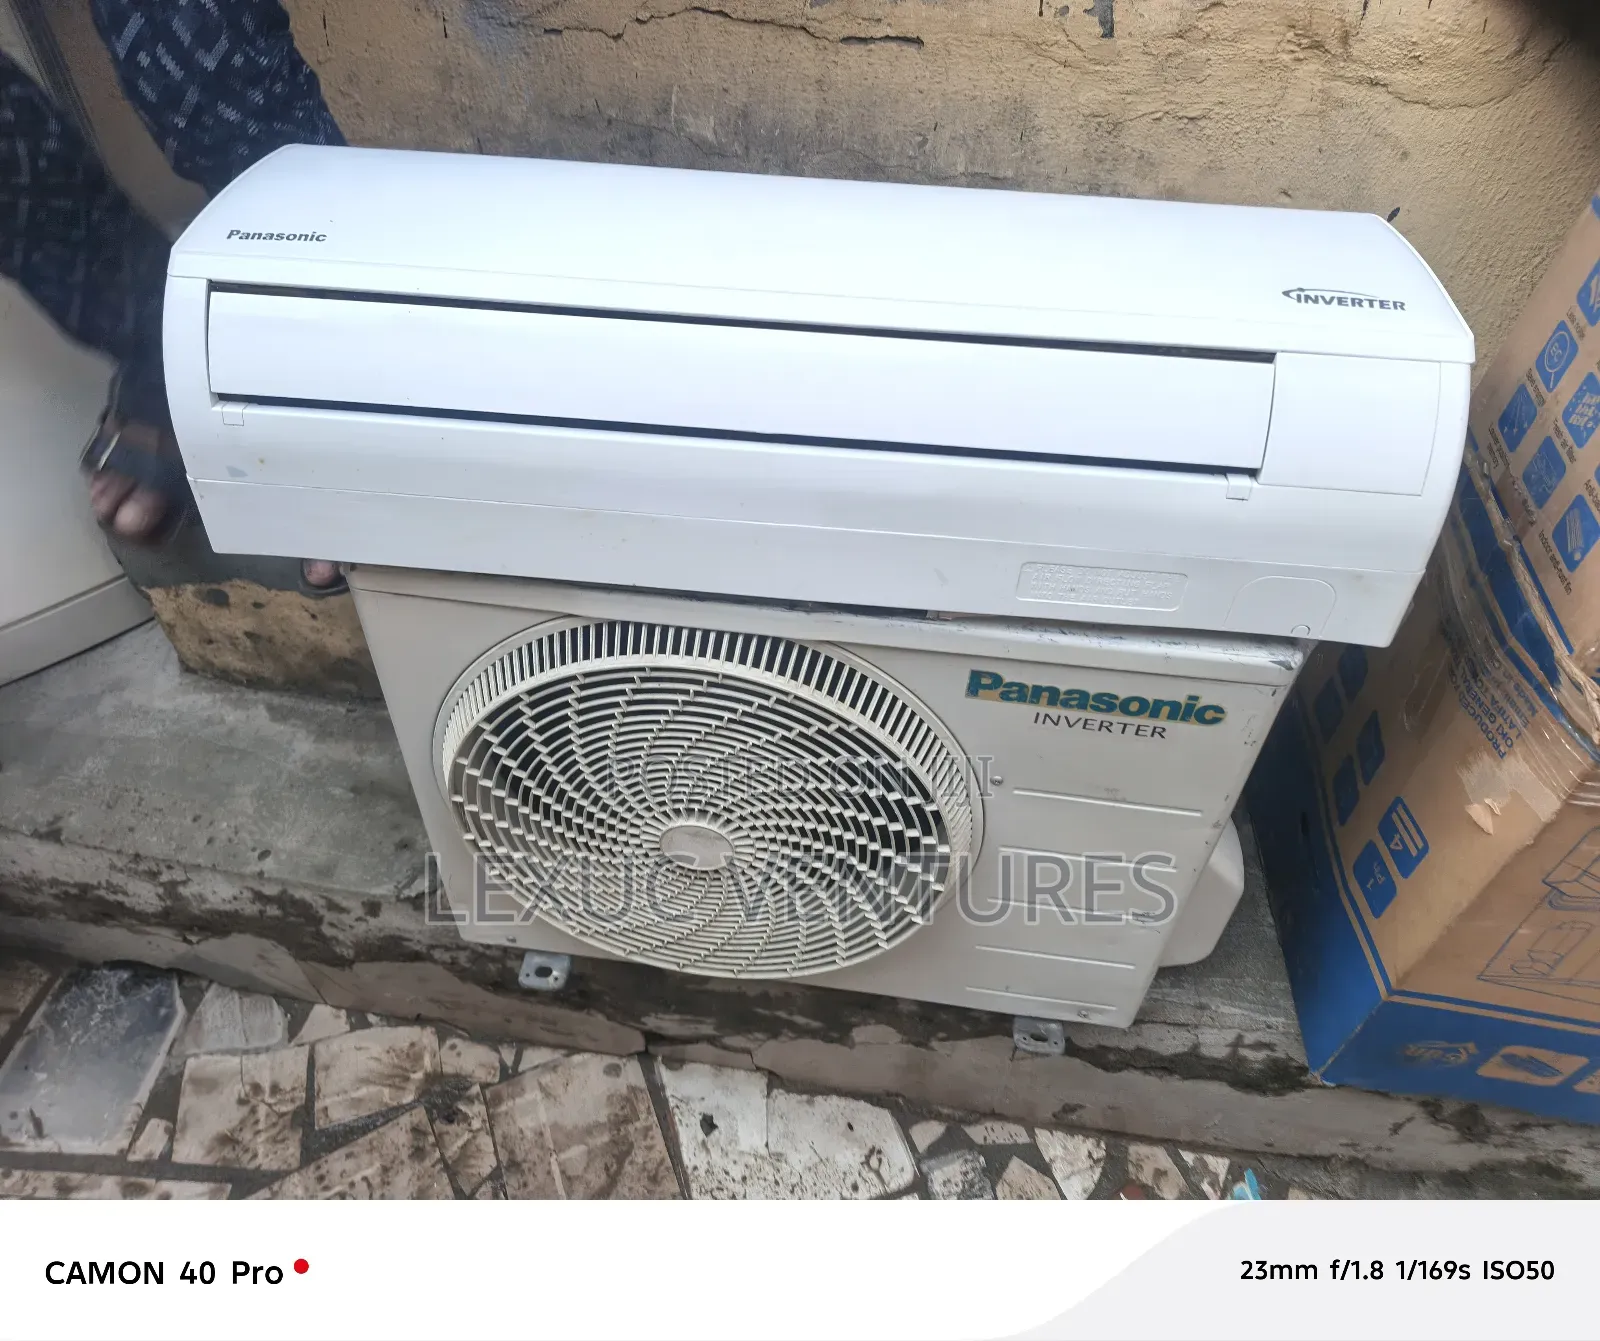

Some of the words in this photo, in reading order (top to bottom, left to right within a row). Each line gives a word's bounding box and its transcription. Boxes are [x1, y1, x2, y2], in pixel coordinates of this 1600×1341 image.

[226, 229, 328, 242] Panasonic
[1294, 288, 1407, 311] INVERTER
[965, 669, 1228, 726] Panasonic
[1034, 711, 1167, 739] INVERTER
[1459, 690, 1506, 759] PRODUCED
[1496, 724, 1513, 748] OKI
